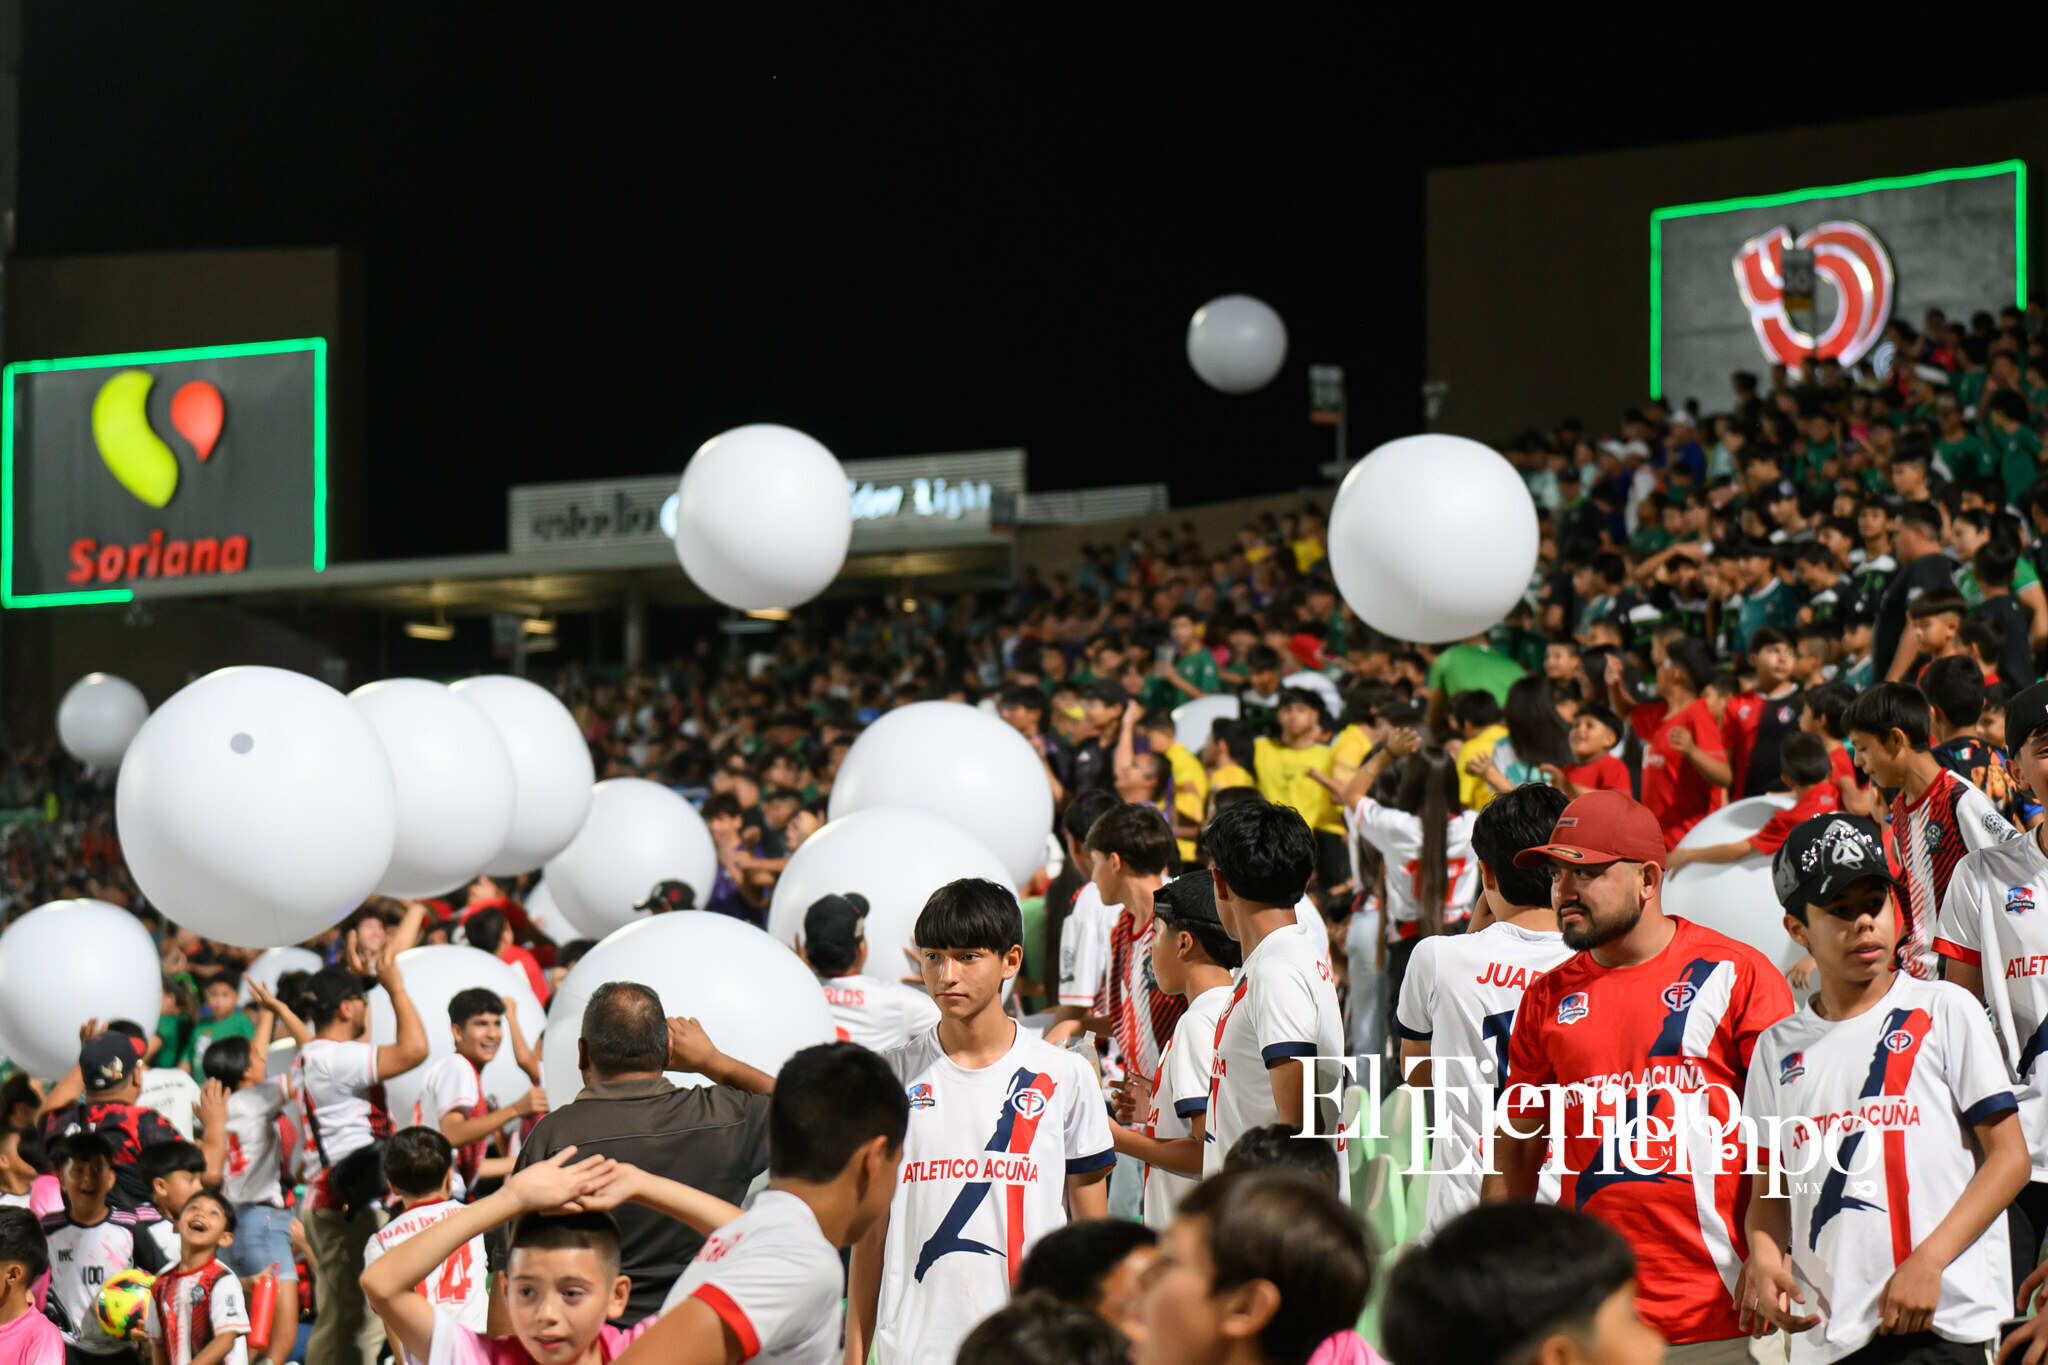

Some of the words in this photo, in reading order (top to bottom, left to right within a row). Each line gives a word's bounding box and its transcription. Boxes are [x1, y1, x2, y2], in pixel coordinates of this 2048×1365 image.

[67, 529, 249, 585] Soriana
[1641, 1059, 1707, 1091] ACUÑA
[1856, 1099, 1921, 1127] ACUÑA
[903, 1158, 979, 1184] ATLETICO
[982, 1156, 1038, 1184] ACUÑA
[376, 1219, 417, 1244] JUAN
